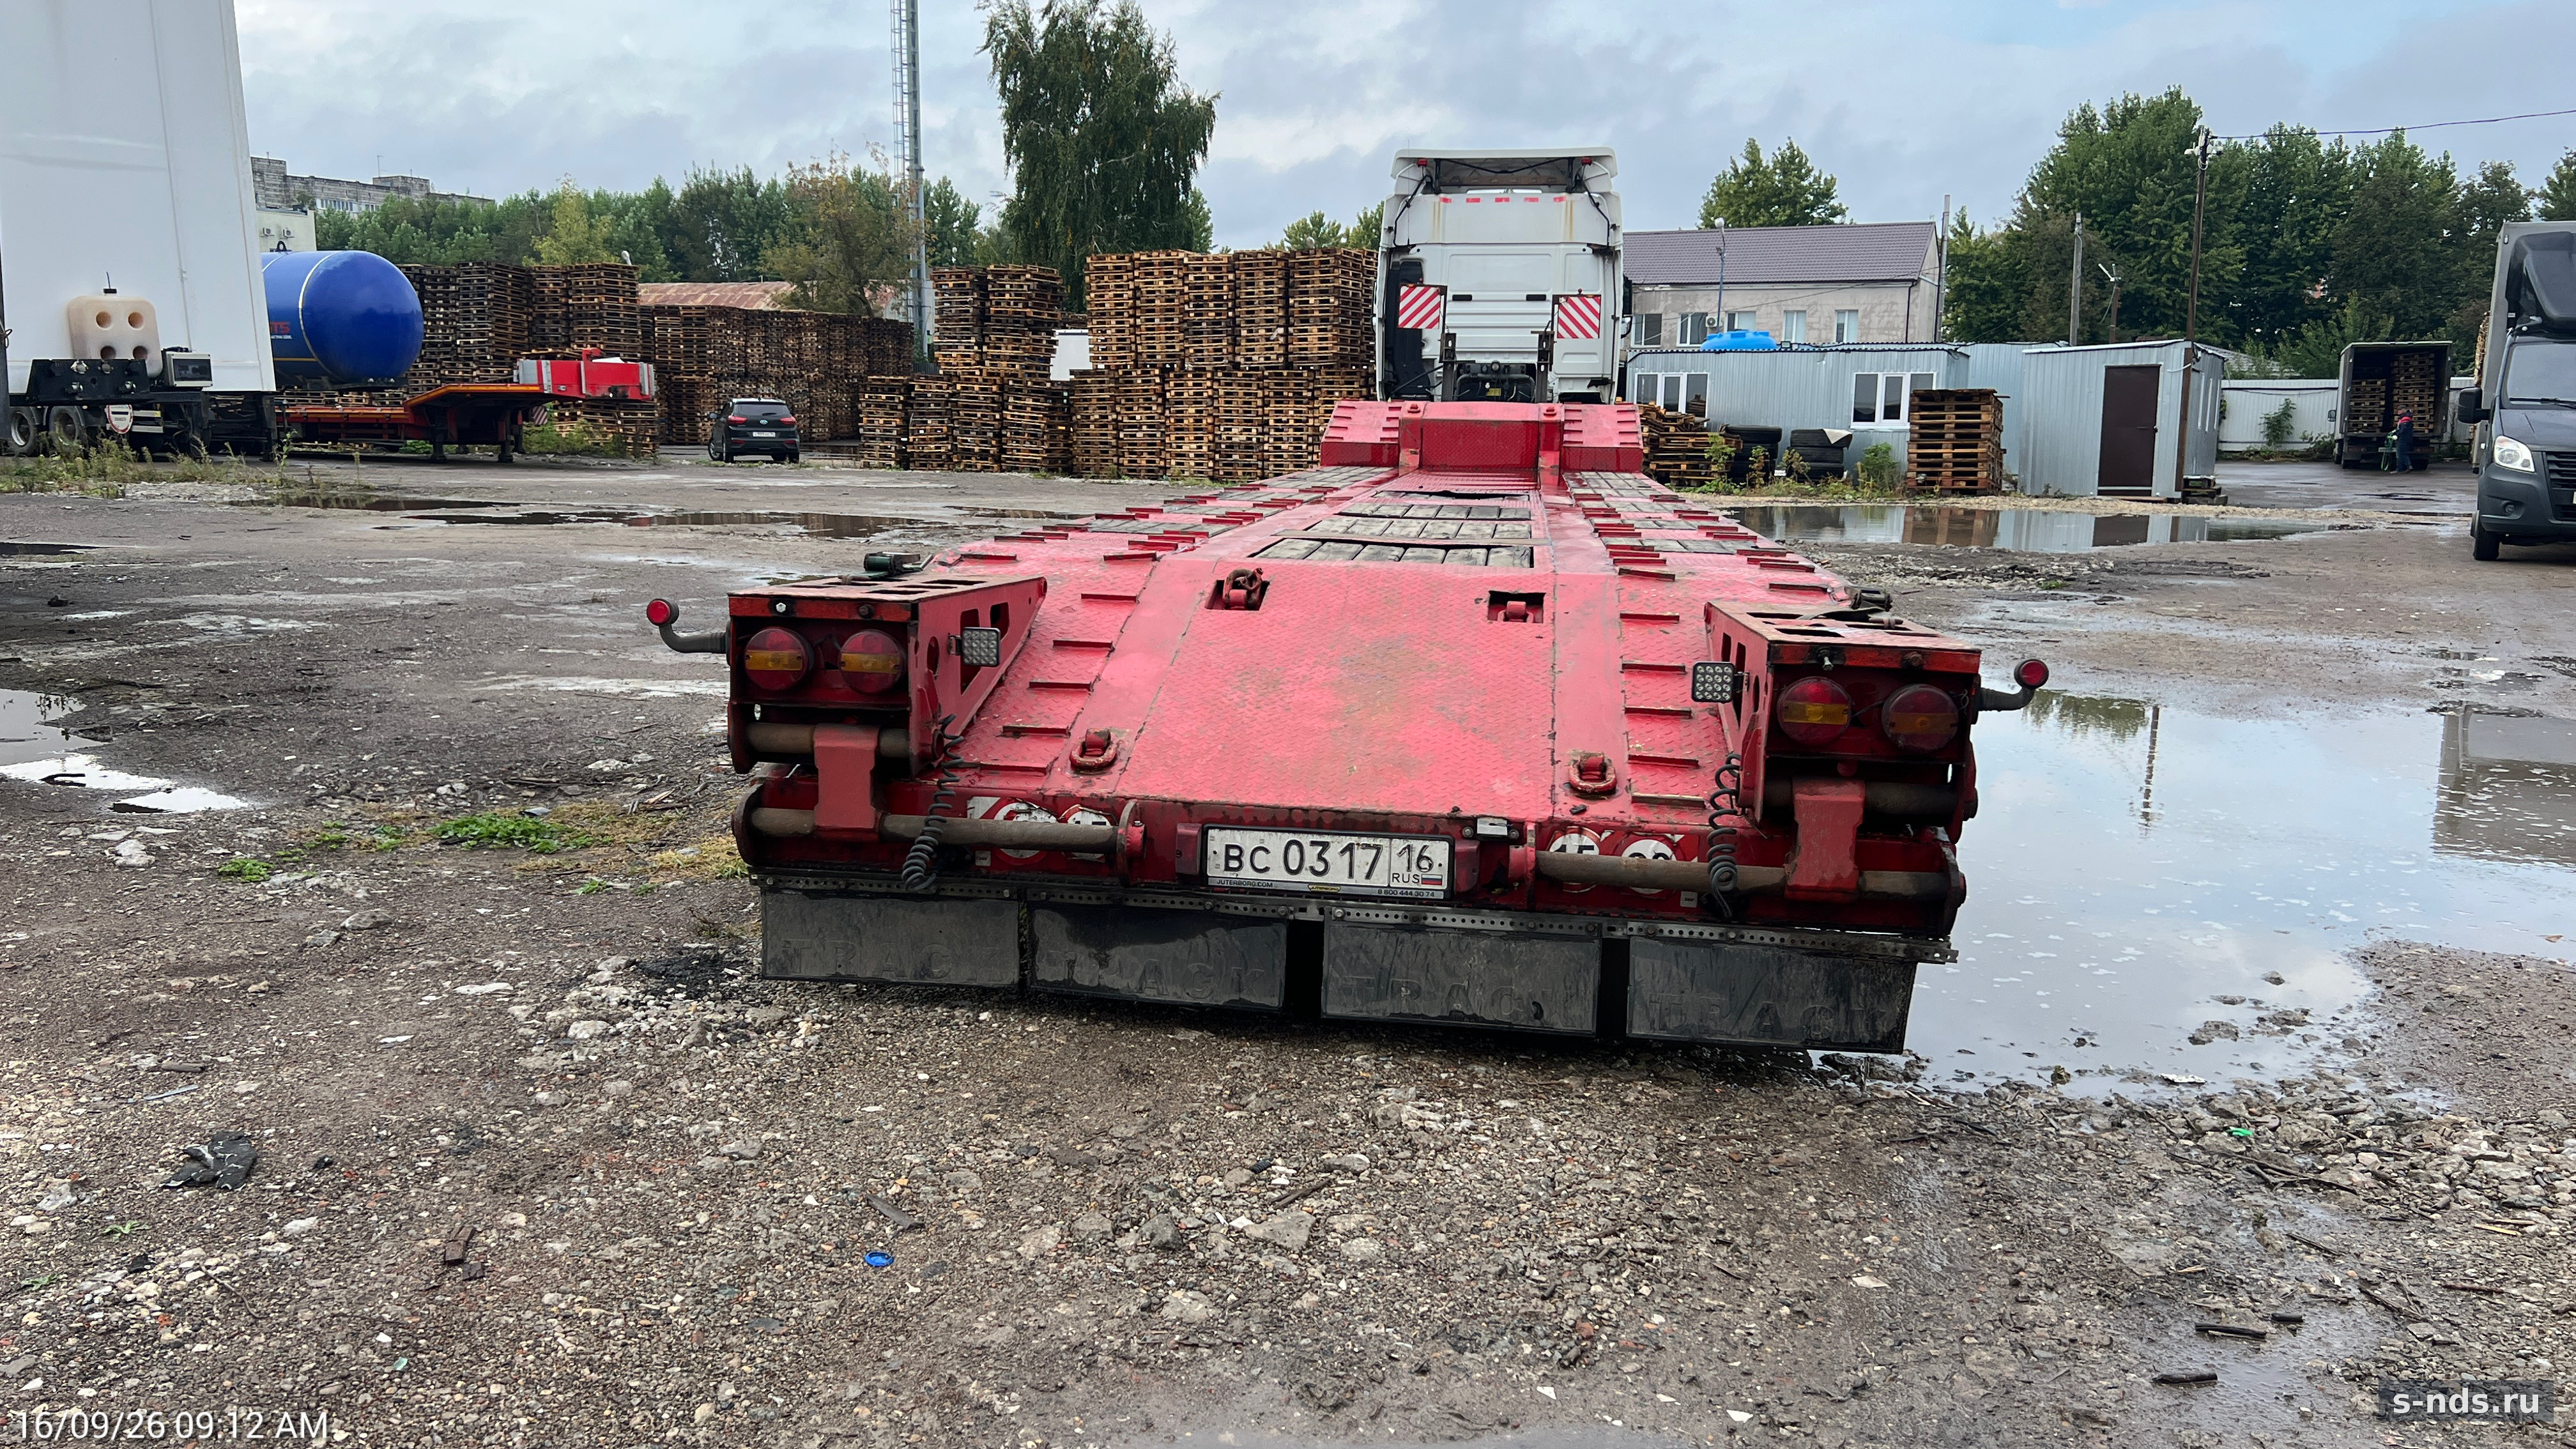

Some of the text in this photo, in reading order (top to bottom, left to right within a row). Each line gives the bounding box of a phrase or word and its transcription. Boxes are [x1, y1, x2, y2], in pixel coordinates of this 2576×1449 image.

[1282, 839, 1384, 880] 0317
[1396, 844, 1434, 873] 16
[1216, 878, 1273, 888] JUTERBORG.COM
[1392, 872, 1420, 884] RUS
